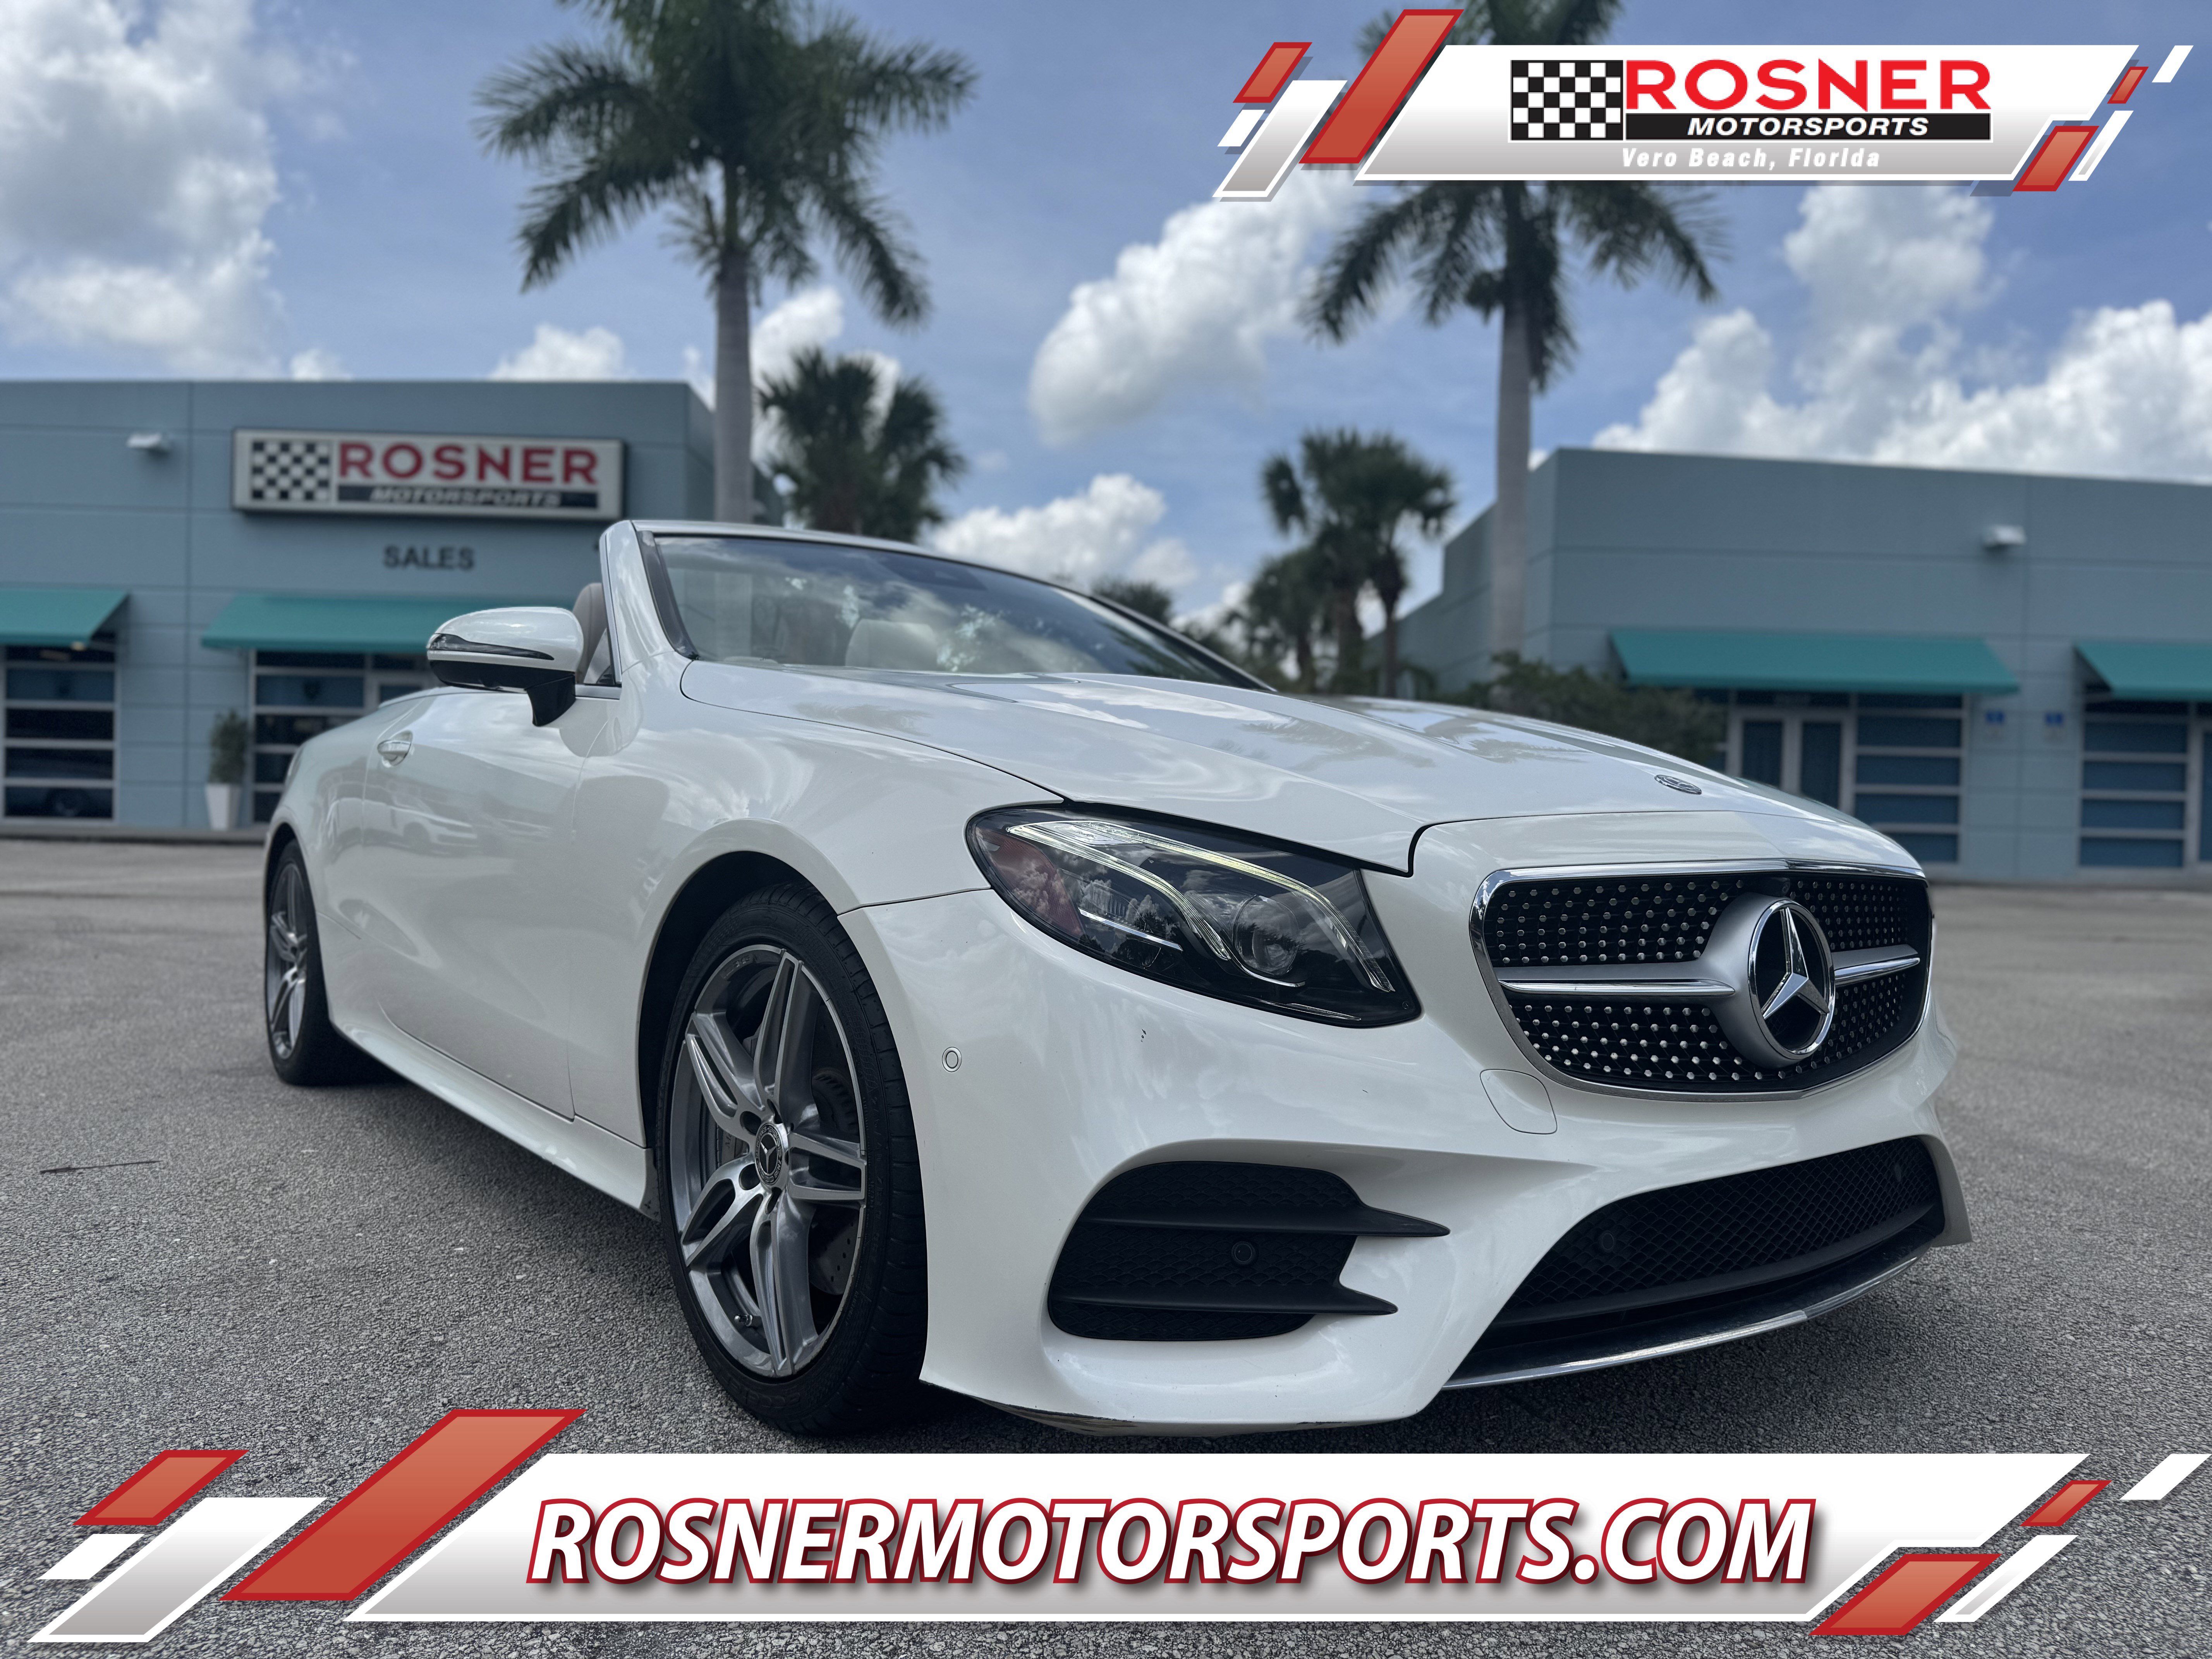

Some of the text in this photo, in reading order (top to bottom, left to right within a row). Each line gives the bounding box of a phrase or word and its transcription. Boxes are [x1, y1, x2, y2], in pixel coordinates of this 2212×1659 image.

[338, 442, 598, 484] ROSNER
[369, 487, 562, 508] MOTORSPORTS
[384, 546, 474, 571] SALES
